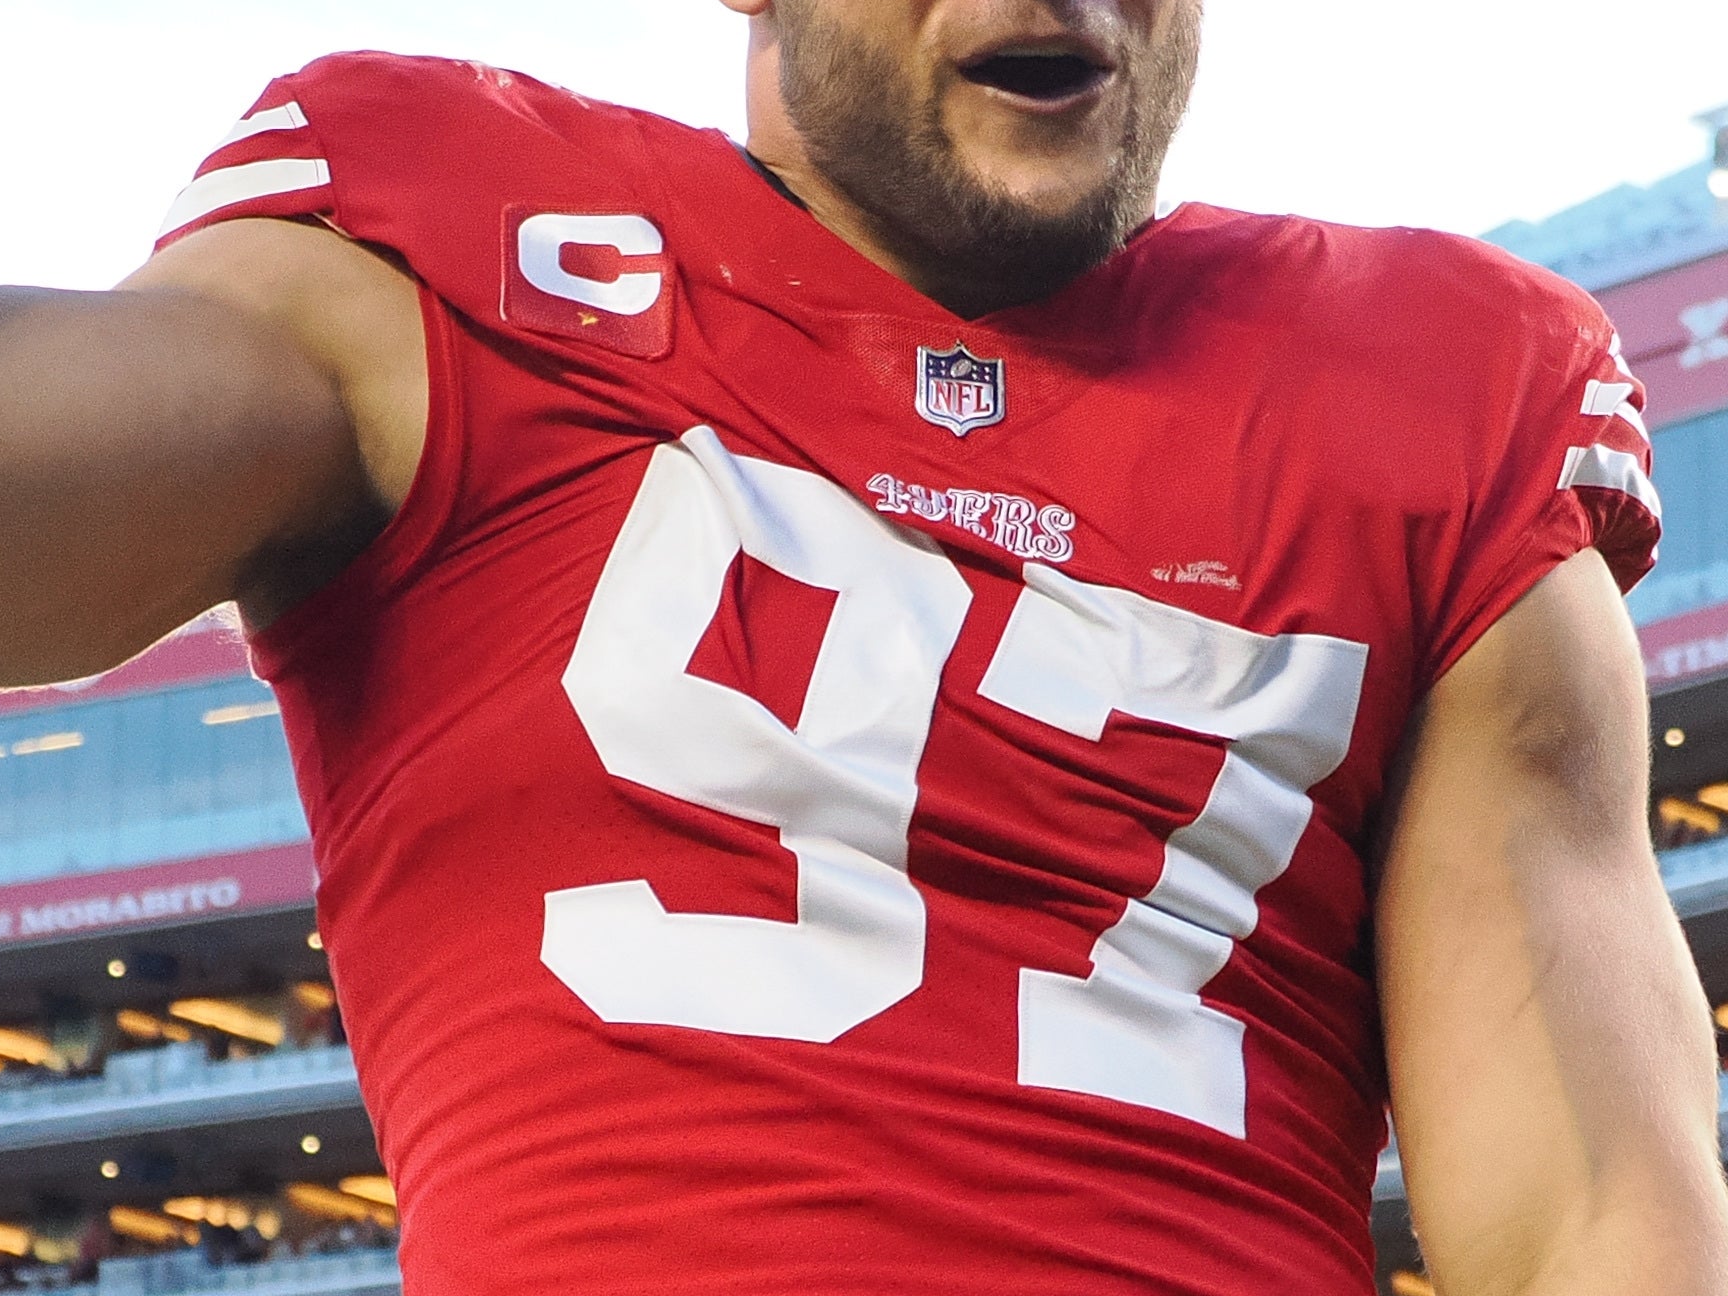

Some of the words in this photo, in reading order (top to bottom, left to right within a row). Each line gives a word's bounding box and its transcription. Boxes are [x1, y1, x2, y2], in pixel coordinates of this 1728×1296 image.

[518, 214, 663, 316] C
[932, 380, 991, 413] NFL
[540, 426, 1369, 1139] 97
[18, 879, 242, 937] MORABITO
